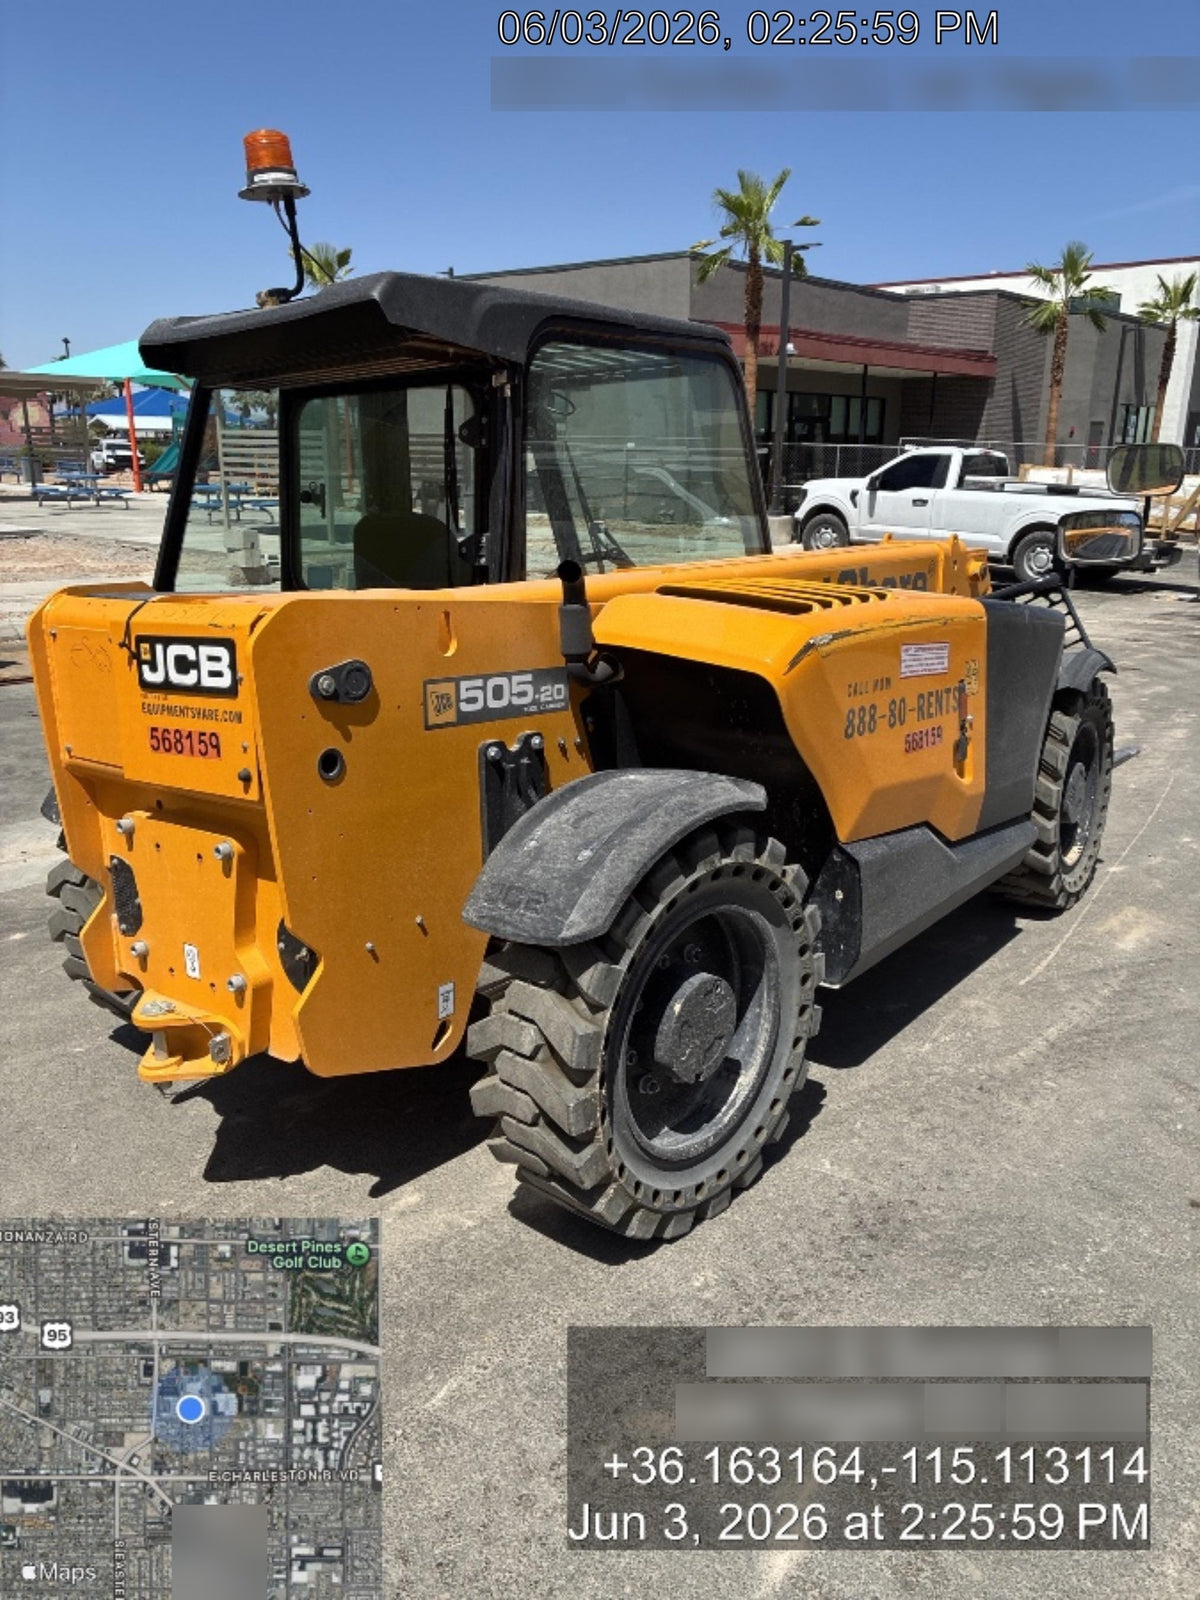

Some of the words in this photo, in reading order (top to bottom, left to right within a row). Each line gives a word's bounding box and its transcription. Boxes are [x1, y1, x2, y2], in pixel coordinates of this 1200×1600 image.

[141, 643, 232, 689] JCB
[141, 702, 243, 725] EQUIPMENTSHARE.COM
[844, 685, 960, 739] 888-80-RENTS
[150, 726, 222, 759] 568159
